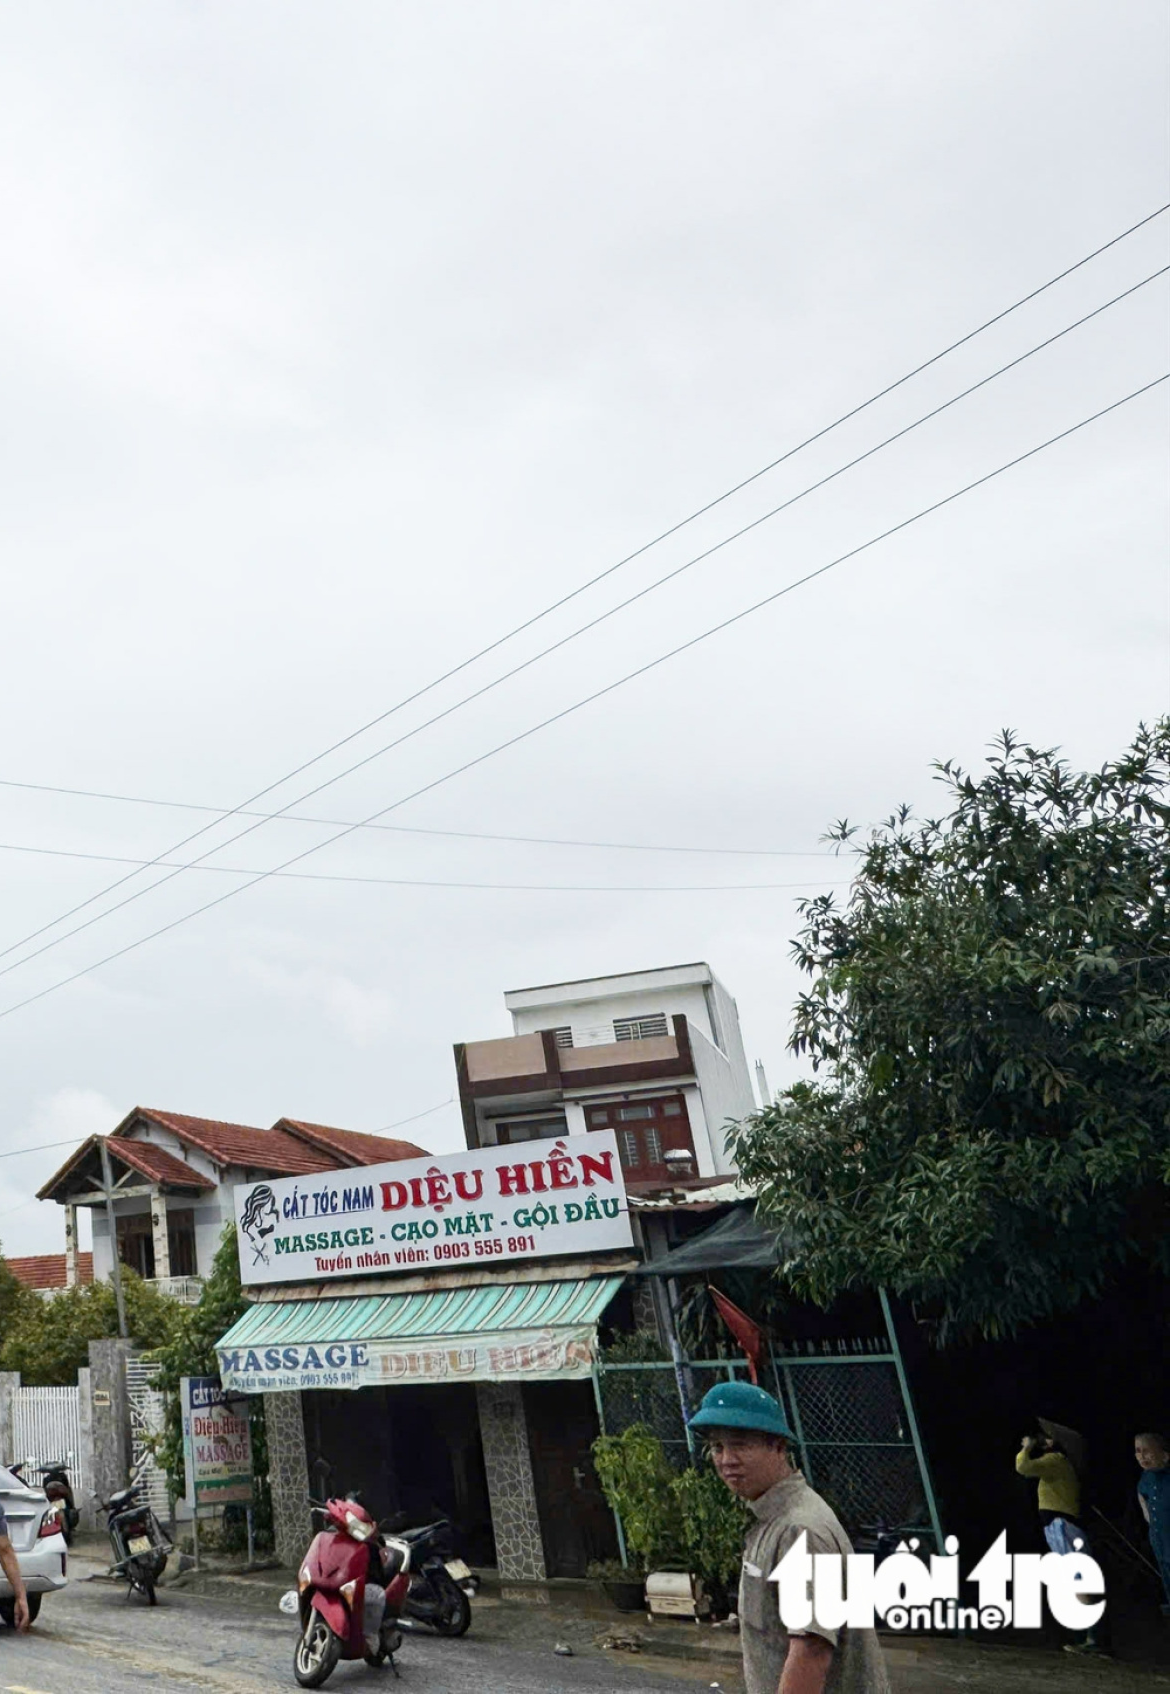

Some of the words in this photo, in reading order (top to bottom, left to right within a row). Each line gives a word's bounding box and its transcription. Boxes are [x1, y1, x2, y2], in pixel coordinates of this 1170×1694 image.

[379, 1166, 484, 1213] DIỆU
[495, 1141, 615, 1197] HIỀN
[312, 1185, 338, 1214] TÓC
[343, 1185, 374, 1211] NAM
[274, 1227, 374, 1255] MASSAGE
[391, 1219, 439, 1245] CẠO
[444, 1211, 494, 1237] MẶT
[513, 1201, 559, 1230] GỘI
[564, 1192, 620, 1222] ĐẦU
[434, 1242, 470, 1260] 0903
[475, 1239, 503, 1256] 555
[508, 1235, 536, 1253] 891
[219, 1343, 370, 1374] MASSAGE
[196, 1443, 249, 1462] MASSAGE
